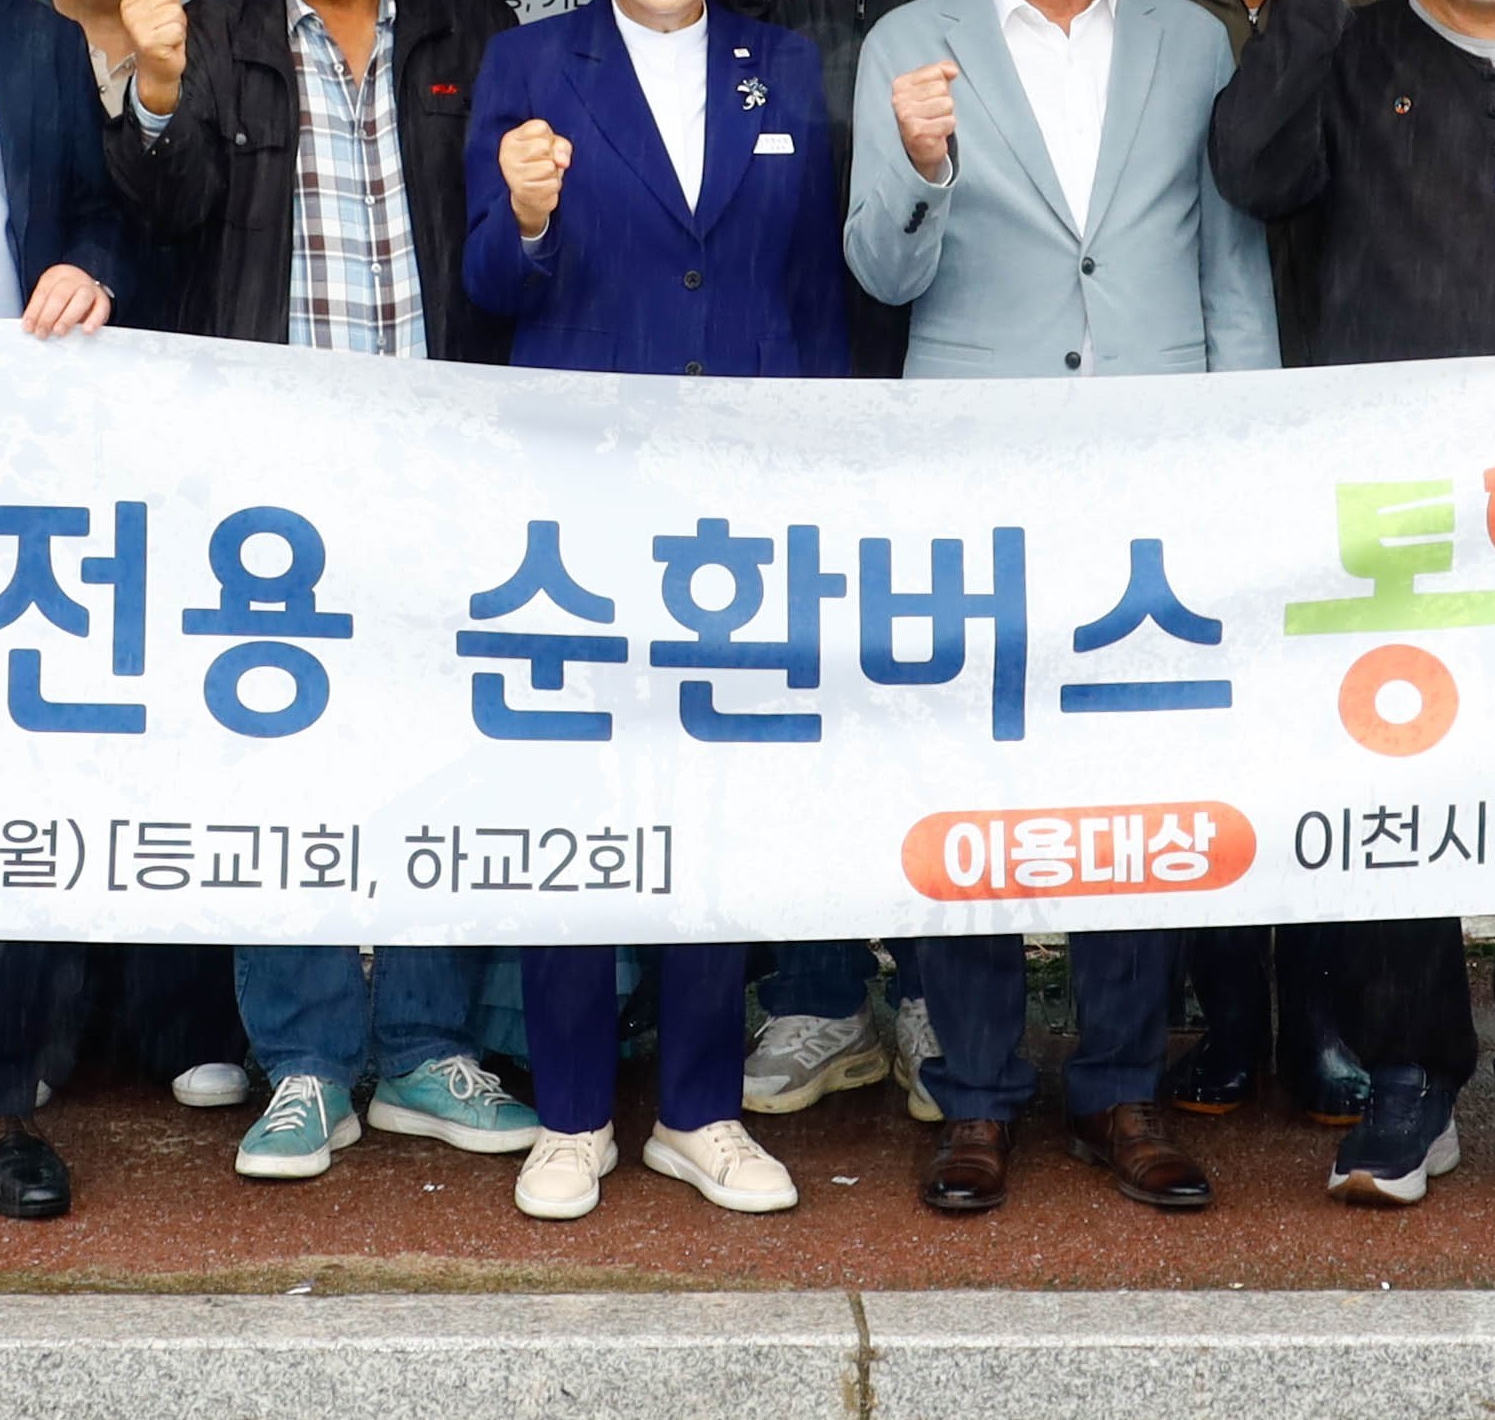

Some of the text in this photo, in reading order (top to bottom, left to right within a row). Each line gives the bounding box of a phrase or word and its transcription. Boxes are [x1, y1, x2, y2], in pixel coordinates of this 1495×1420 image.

[456, 517, 1233, 743] 순환버스
[107, 818, 378, 900] [등교1회,
[405, 823, 674, 896] 하교2회]
[942, 810, 1218, 890] 이용대상
[1293, 797, 1488, 872] 이천시
